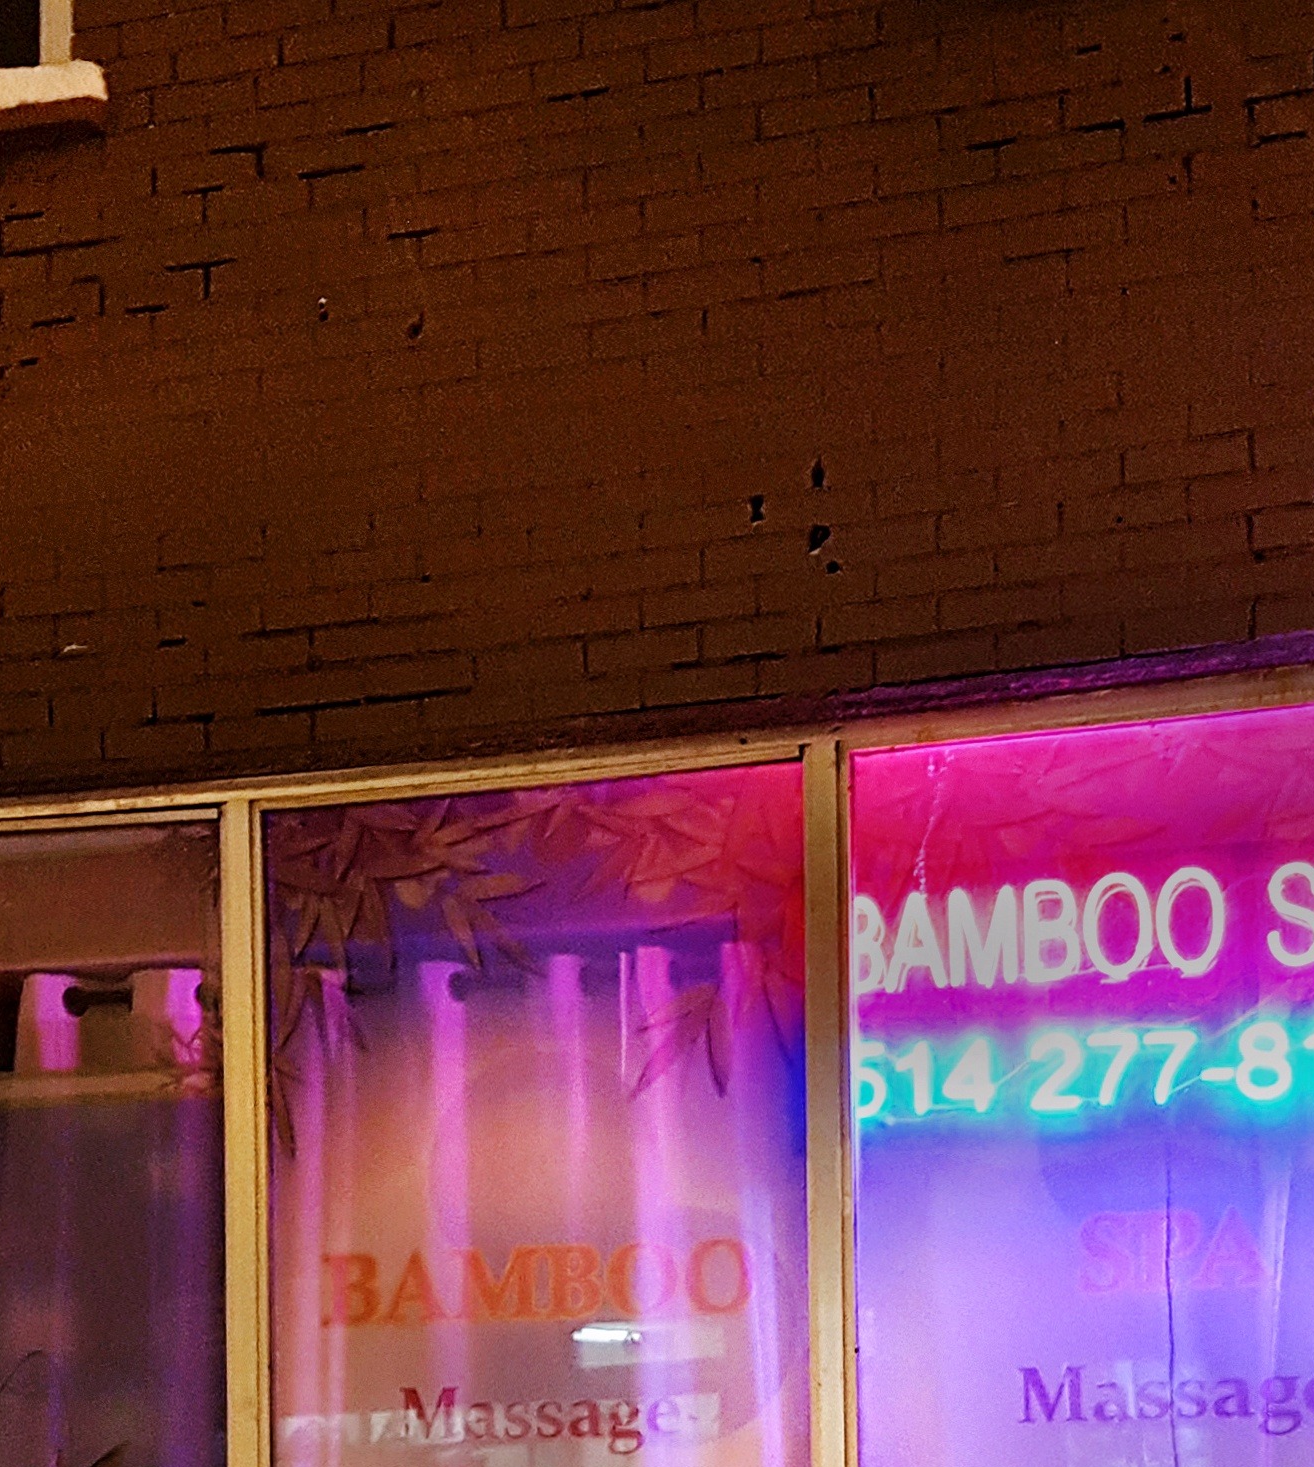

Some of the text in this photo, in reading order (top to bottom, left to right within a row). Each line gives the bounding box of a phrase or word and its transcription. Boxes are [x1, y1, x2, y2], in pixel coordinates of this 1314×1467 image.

[853, 866, 1226, 994] BAMBOO
[854, 1038, 997, 1118] 514
[321, 1203, 1272, 1328] BAMBOO SPA
